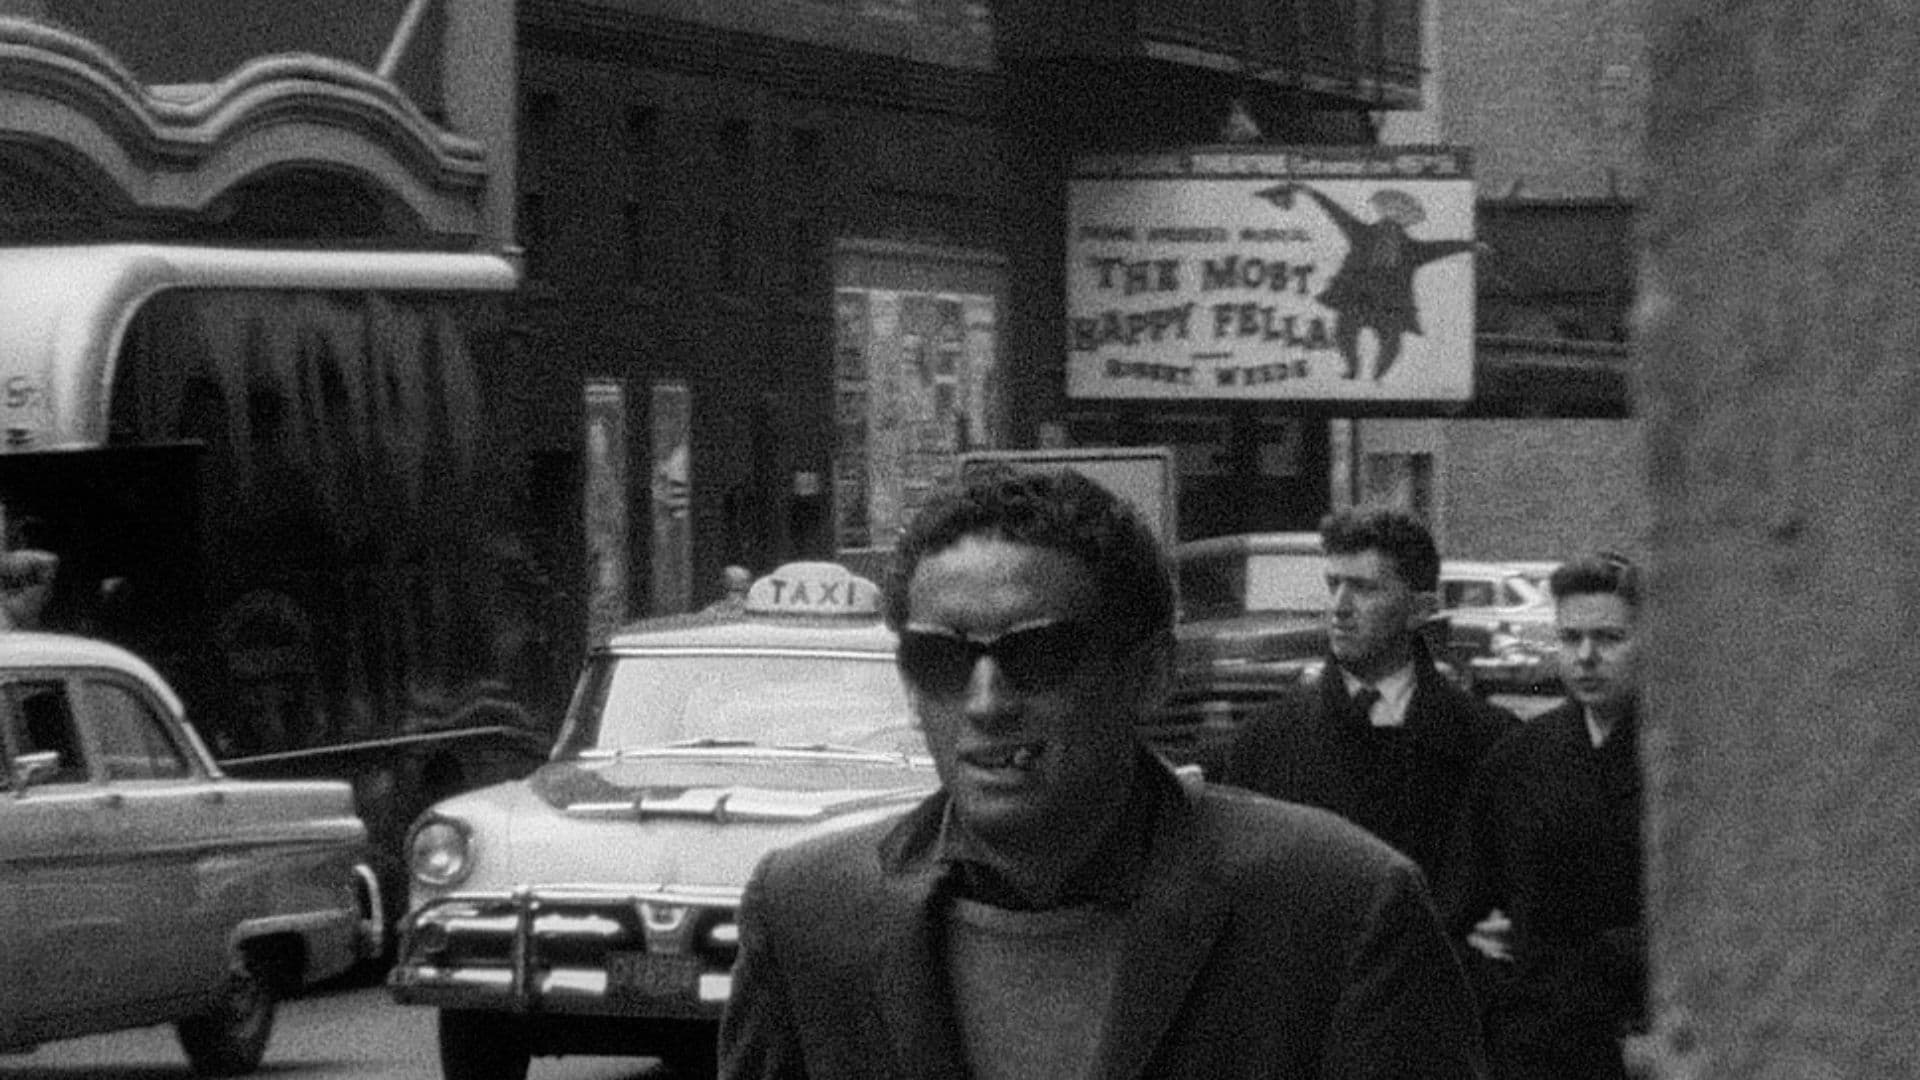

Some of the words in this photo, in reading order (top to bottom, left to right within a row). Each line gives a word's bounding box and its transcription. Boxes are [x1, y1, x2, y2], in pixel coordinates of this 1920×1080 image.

[1087, 256, 1179, 295] THE
[1201, 254, 1316, 294] MOST
[1067, 302, 1194, 351] HAPPY
[1213, 303, 1328, 350] FELLA
[772, 580, 853, 605] TAXI
